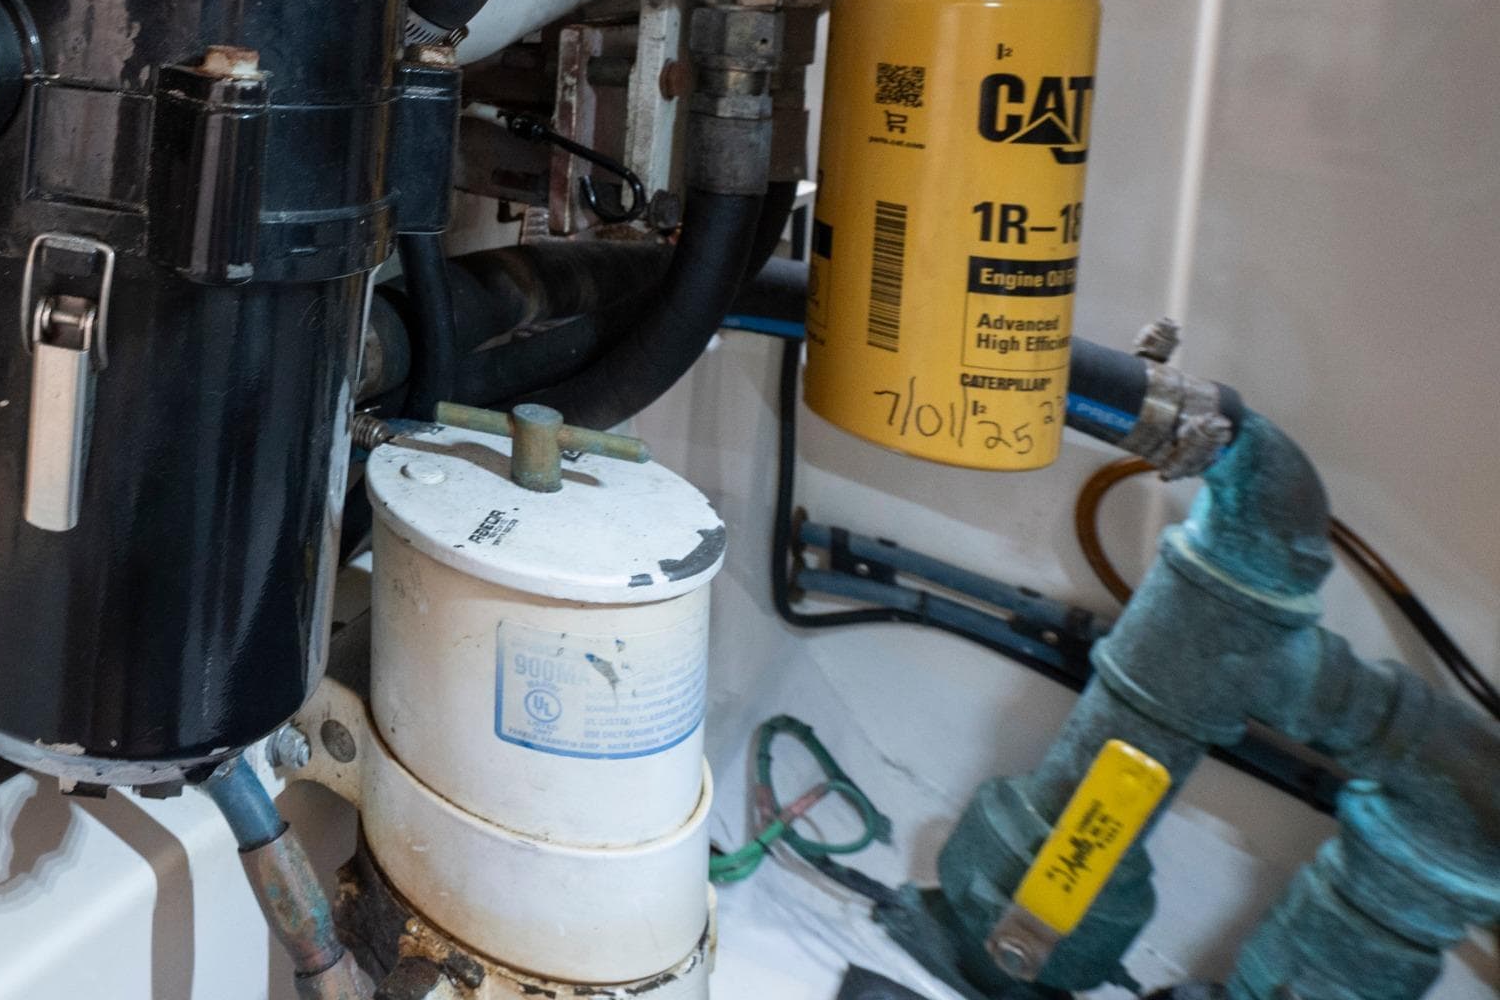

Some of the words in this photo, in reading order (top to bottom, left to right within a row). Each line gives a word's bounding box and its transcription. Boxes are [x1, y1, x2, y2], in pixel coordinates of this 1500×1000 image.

[978, 73, 1095, 144] CAT
[980, 268, 1044, 291] Engine
[977, 313, 1060, 332] Advanced
[976, 333, 1020, 354] High
[873, 376, 1034, 454] 7/01/25
[533, 695, 554, 718] UL
